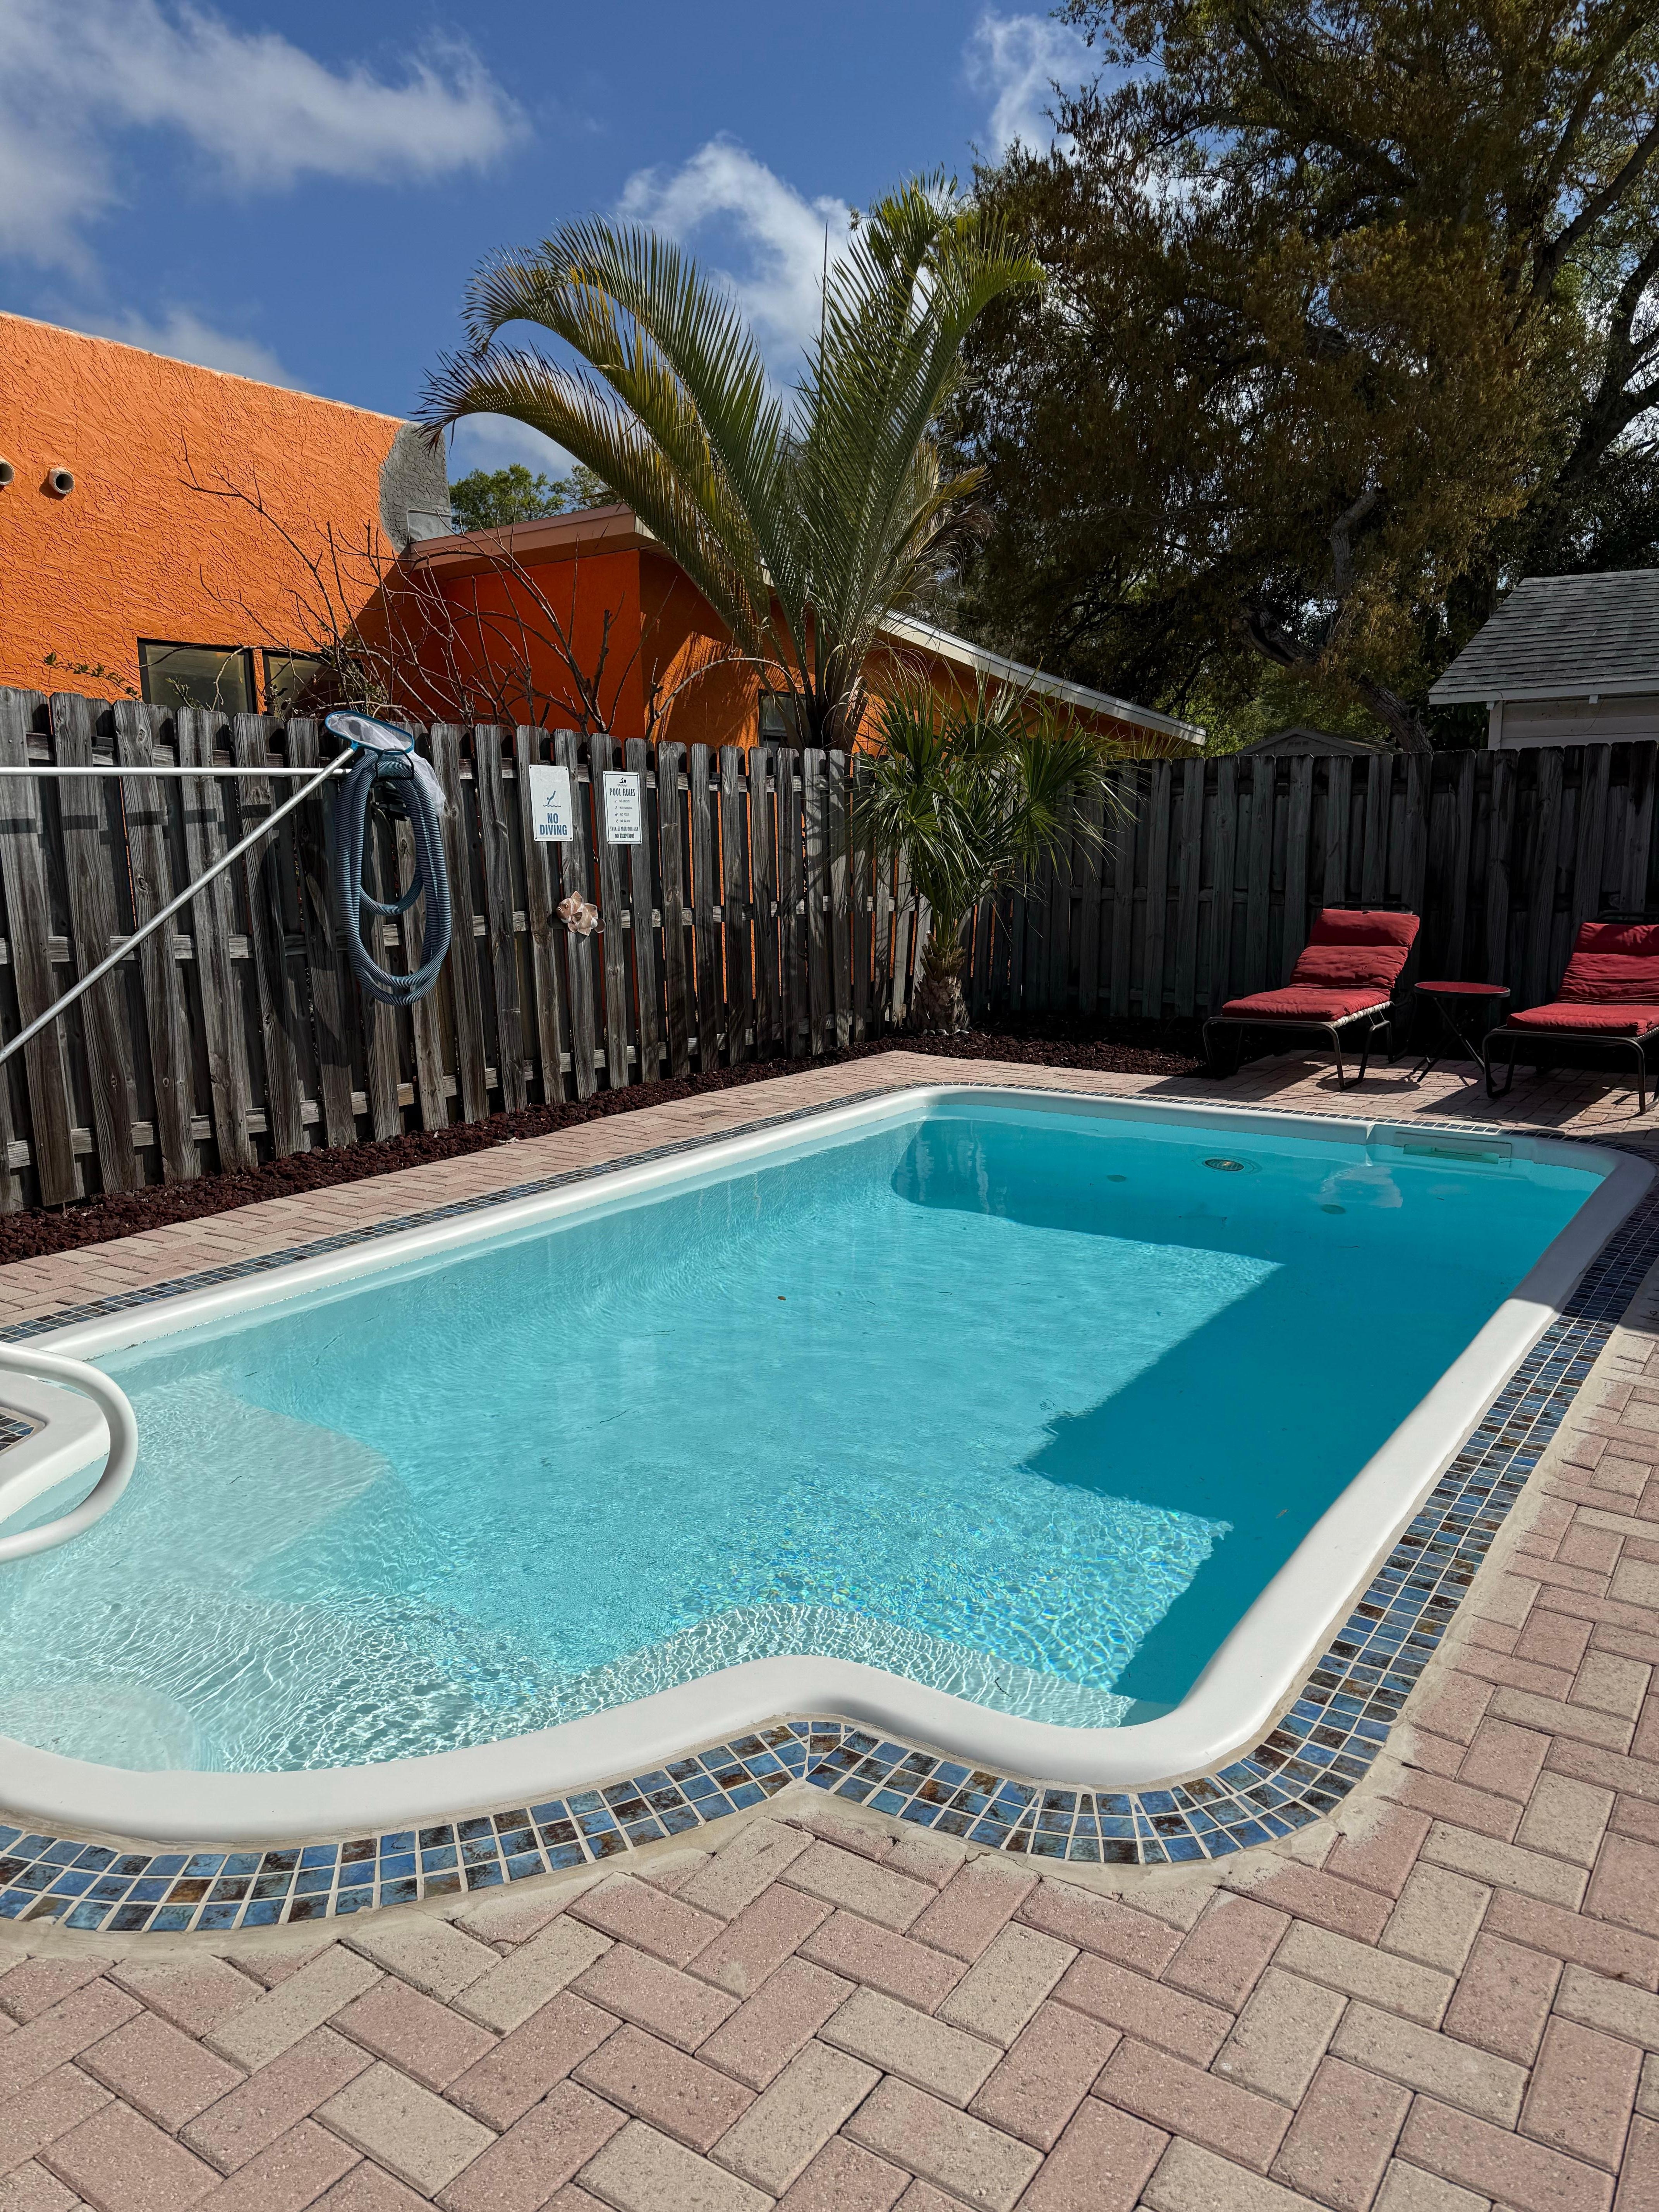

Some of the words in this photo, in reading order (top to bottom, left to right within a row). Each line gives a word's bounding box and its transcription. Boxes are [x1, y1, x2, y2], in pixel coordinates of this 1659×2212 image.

[623, 788, 635, 796] RULES
[547, 813, 558, 824] NO
[540, 824, 567, 835] DIVING
